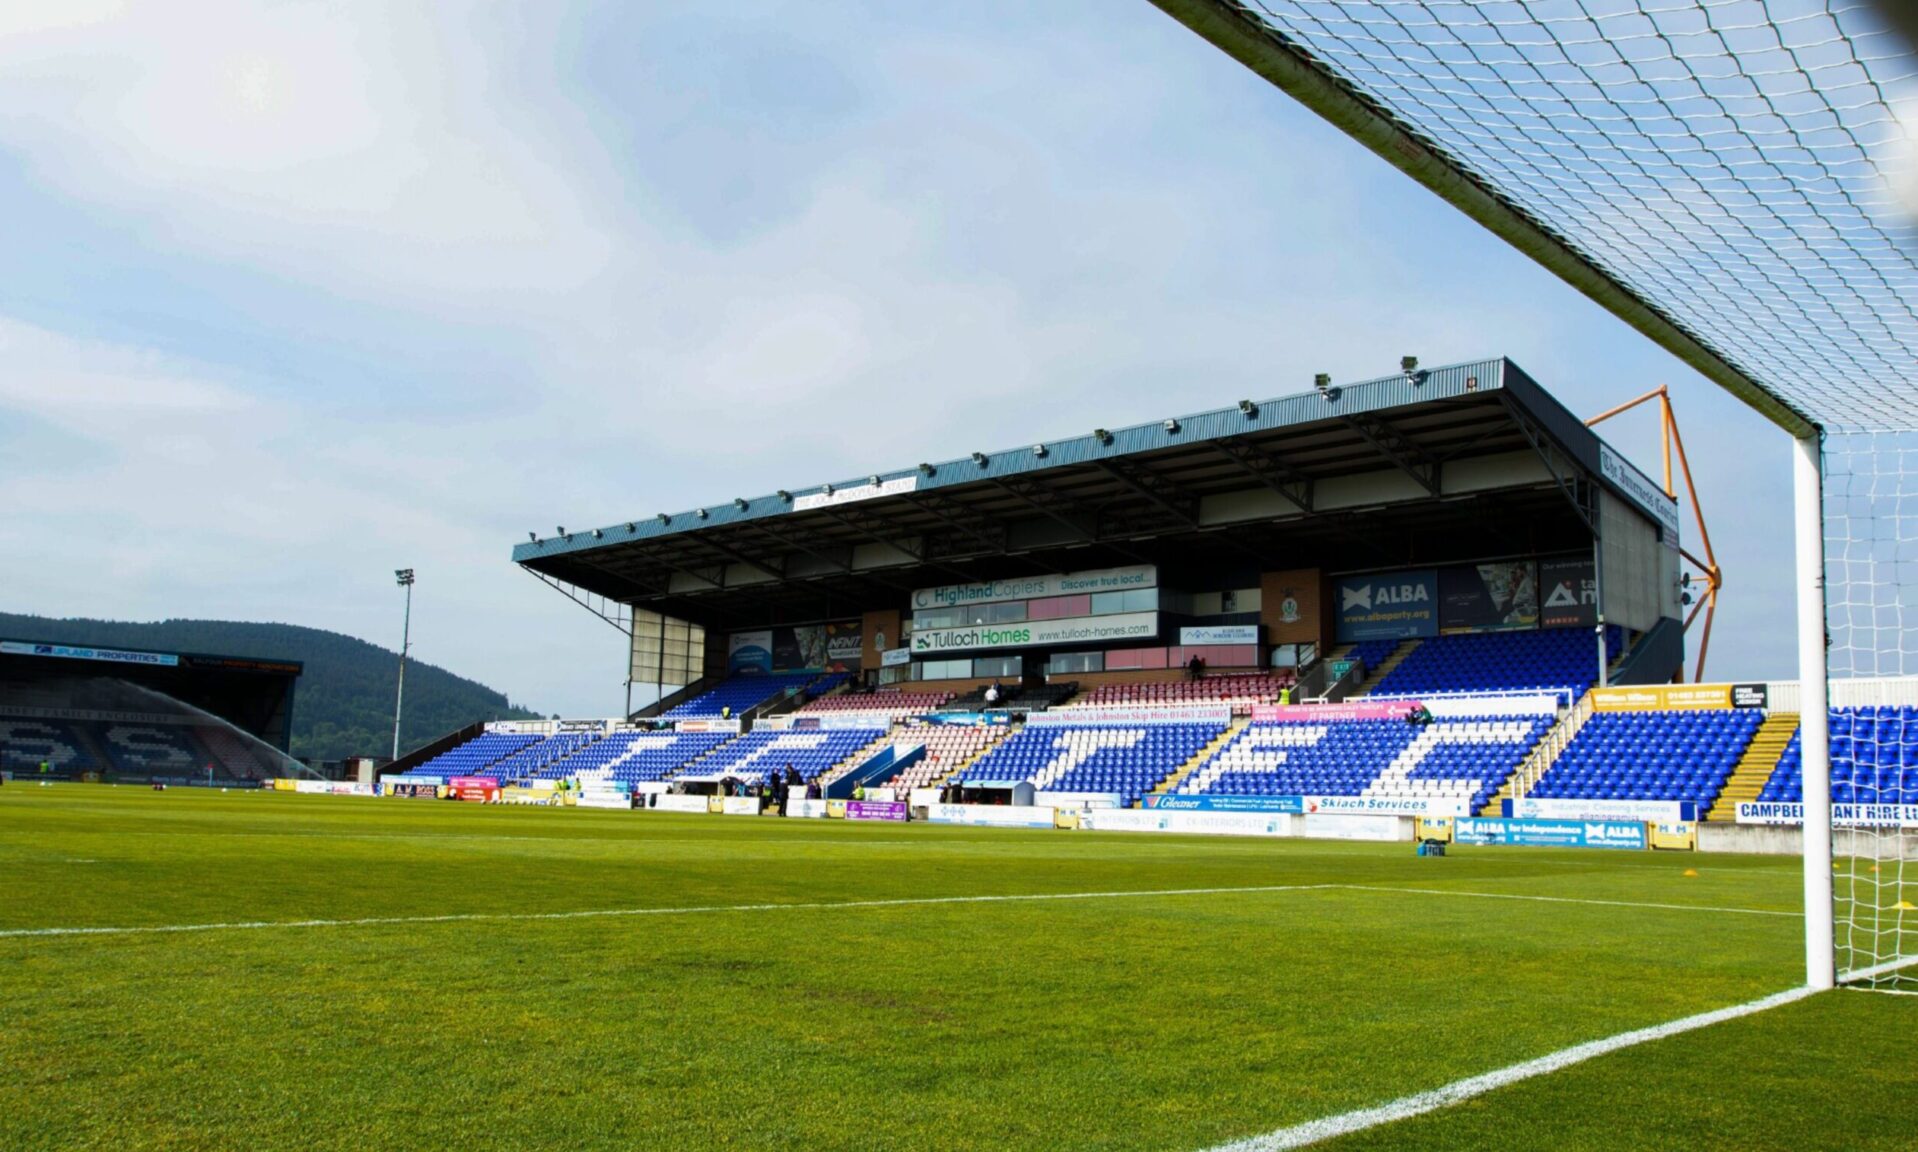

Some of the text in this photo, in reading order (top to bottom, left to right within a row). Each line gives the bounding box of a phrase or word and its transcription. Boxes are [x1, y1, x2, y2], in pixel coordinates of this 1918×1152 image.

[1061, 578, 1098, 590] Discover
[1100, 576, 1118, 586] true
[1375, 584, 1429, 605] ALBA
[932, 628, 1031, 648] Tulloch Homes
[1038, 624, 1149, 641] www.tulloch-homes.com
[53, 646, 94, 658] UPLAND
[97, 650, 158, 663] PROPERTIES
[1029, 714, 1060, 722] Johnston
[1062, 713, 1086, 722] Metals
[1096, 712, 1129, 722] Johnston
[1131, 711, 1149, 722] Skip
[1150, 711, 1167, 719] Hire
[1319, 711, 1356, 720] PARTNER
[1160, 797, 1201, 809] Gleaner
[1320, 798, 1428, 810] Skiach Services
[1593, 803, 1631, 813] Cleaning
[1634, 804, 1671, 813] Services
[1833, 805, 1861, 819] ANT
[1866, 806, 1900, 820] HIRE
[1475, 822, 1641, 838] ALBA for Independence ALBA
